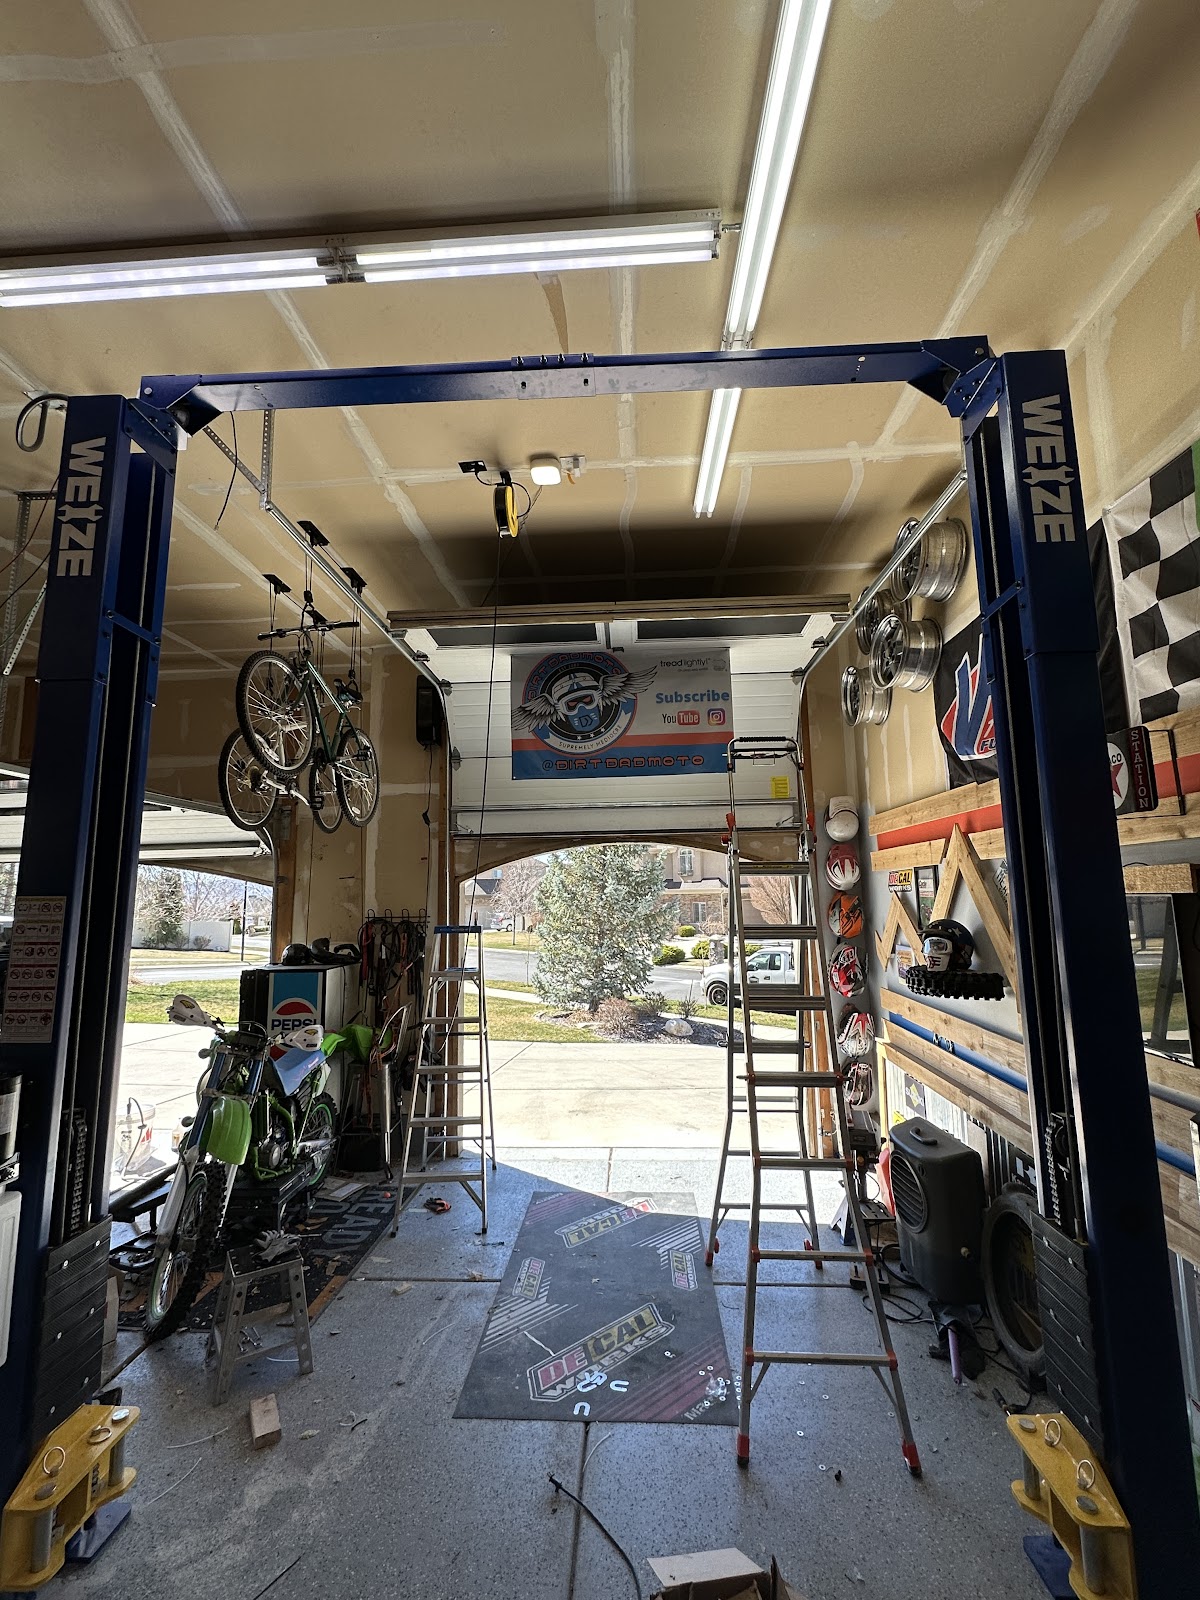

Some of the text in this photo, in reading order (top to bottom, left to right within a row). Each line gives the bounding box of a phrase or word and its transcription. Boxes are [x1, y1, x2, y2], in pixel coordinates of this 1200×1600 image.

[655, 690, 730, 704] Subscribe
[558, 725, 623, 751] SUPREMELY MEDIOCRE
[1130, 729, 1149, 808] STATION
[888, 869, 912, 887] DECAL
[673, 1252, 689, 1289] DECAL
[685, 1254, 696, 1289] WORKS
[538, 1308, 656, 1391] DECAL
